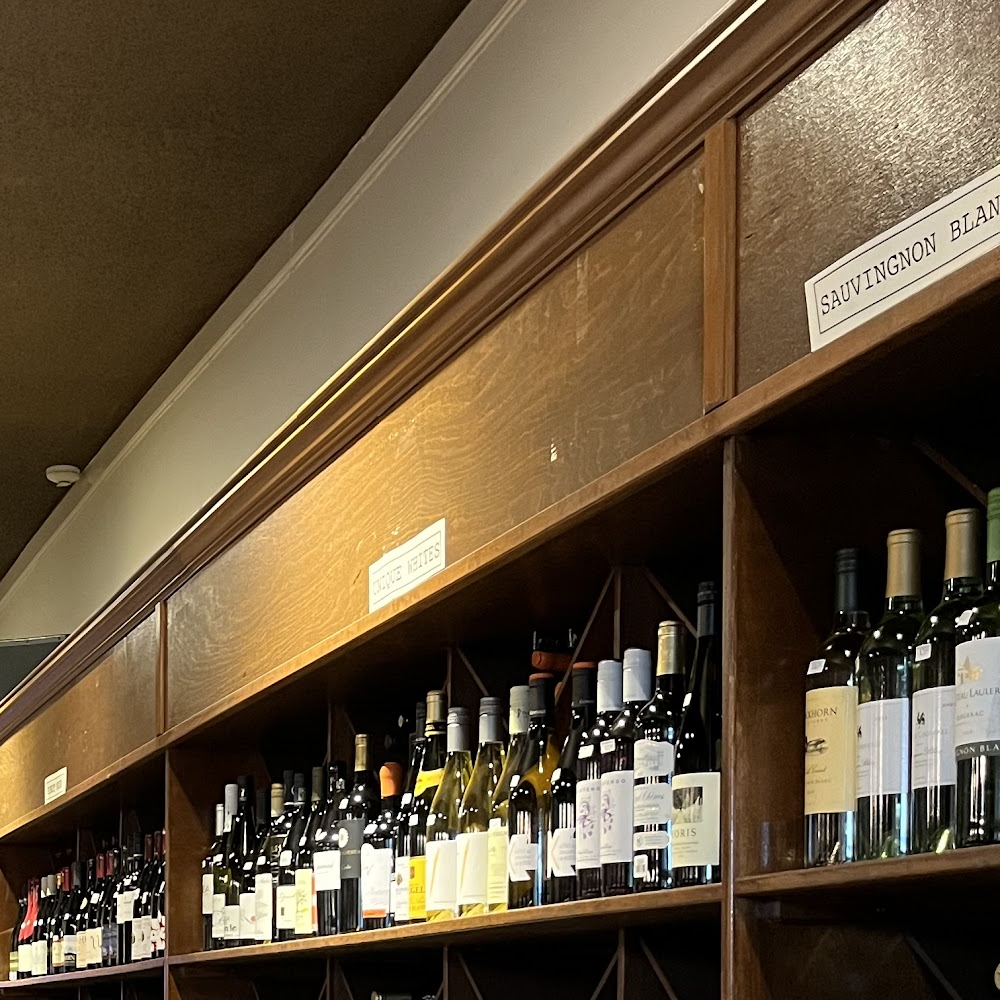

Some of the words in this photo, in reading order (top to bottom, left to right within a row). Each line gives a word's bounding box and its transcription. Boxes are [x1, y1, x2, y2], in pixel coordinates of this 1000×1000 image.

[820, 233, 938, 316] SAUVINGNON
[373, 565, 402, 596] UNIQUE
[407, 542, 440, 576] WHITES
